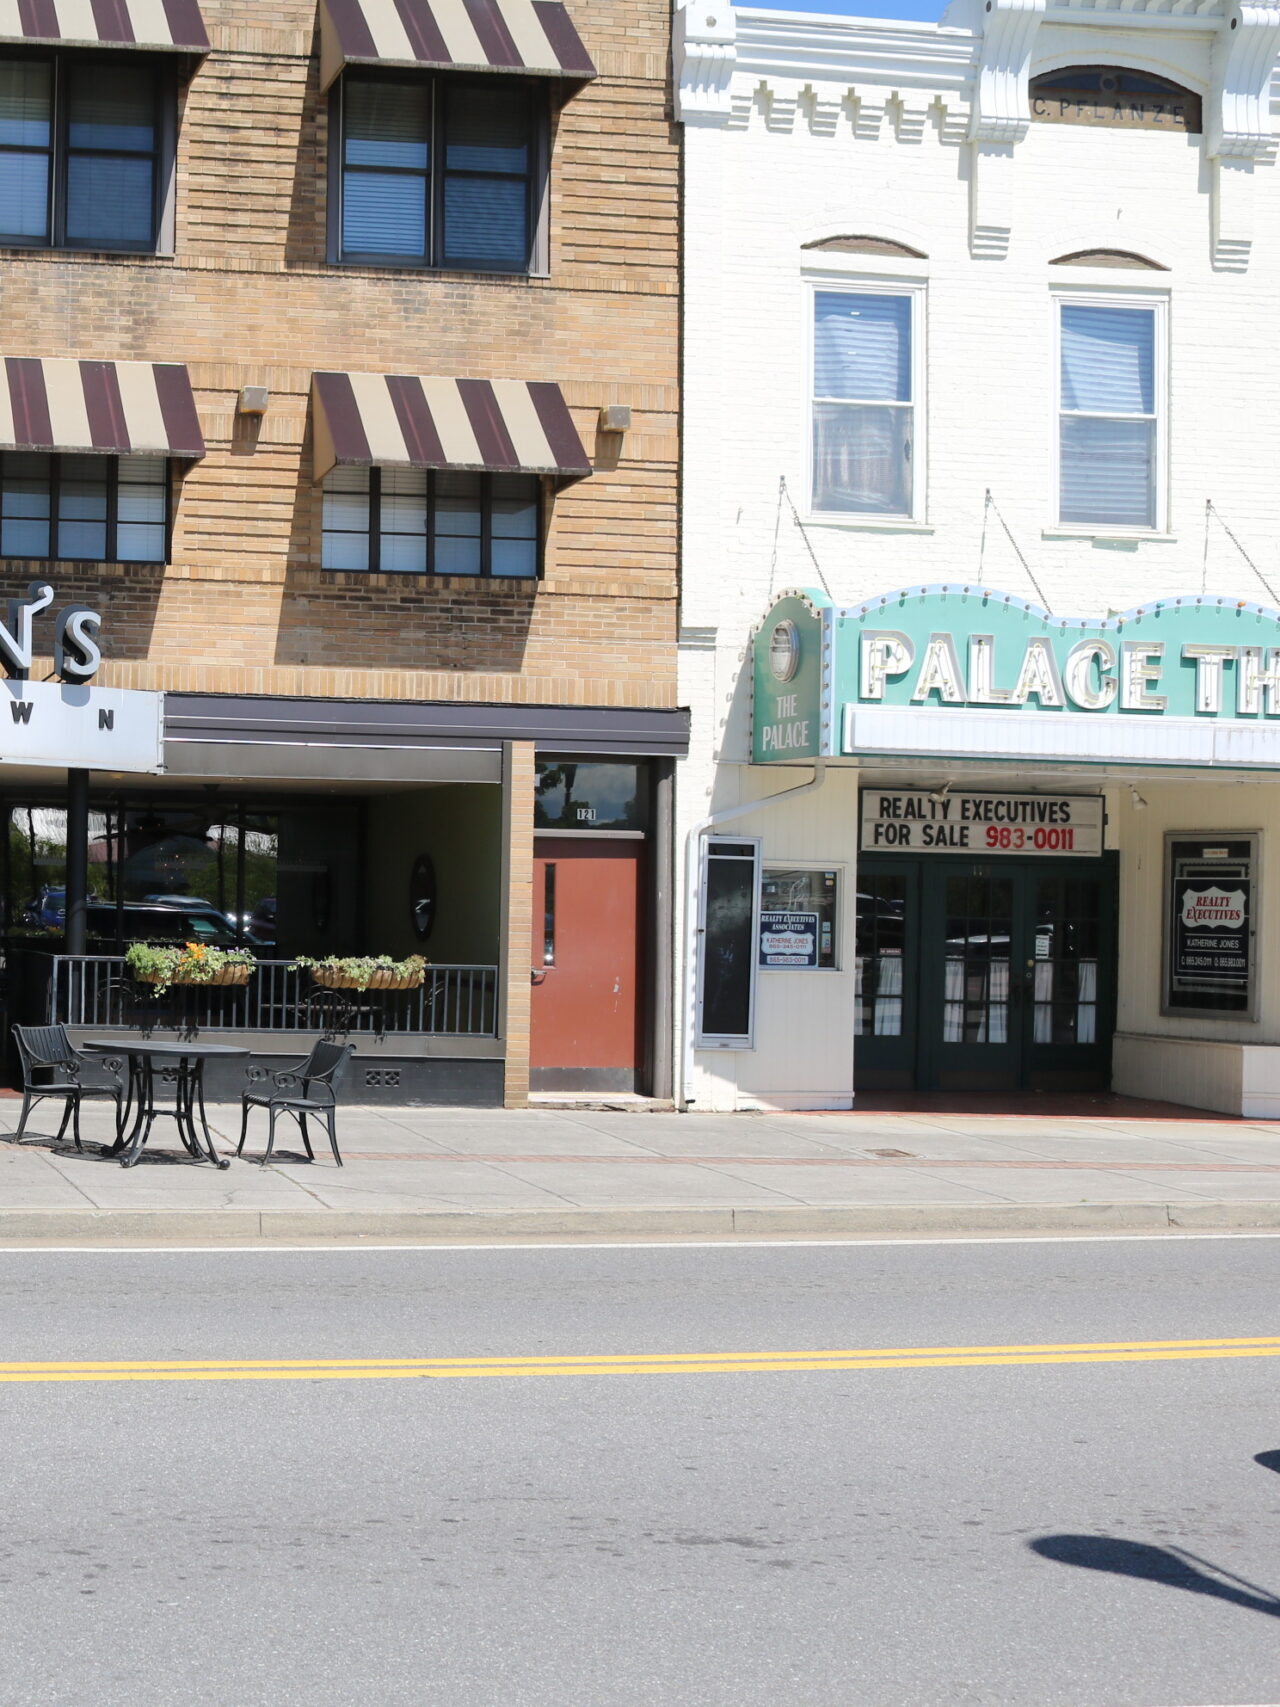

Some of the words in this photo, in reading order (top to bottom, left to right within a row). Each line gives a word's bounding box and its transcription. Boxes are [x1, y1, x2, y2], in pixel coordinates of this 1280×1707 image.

[858, 629, 1168, 711] PALACE
[776, 694, 798, 719] THE
[762, 720, 809, 751] PALACE
[578, 809, 595, 820] 121
[880, 796, 951, 820] REALTY
[961, 799, 1071, 824] EXECUTIVES
[874, 822, 911, 846] FOR
[922, 823, 970, 848] SALE
[985, 825, 1074, 850] 983-0011
[1196, 896, 1232, 907] REALTY
[1186, 906, 1241, 923] EXECUTIVES
[1186, 938, 1218, 948] KATHERINE
[1219, 940, 1240, 949] JONES
